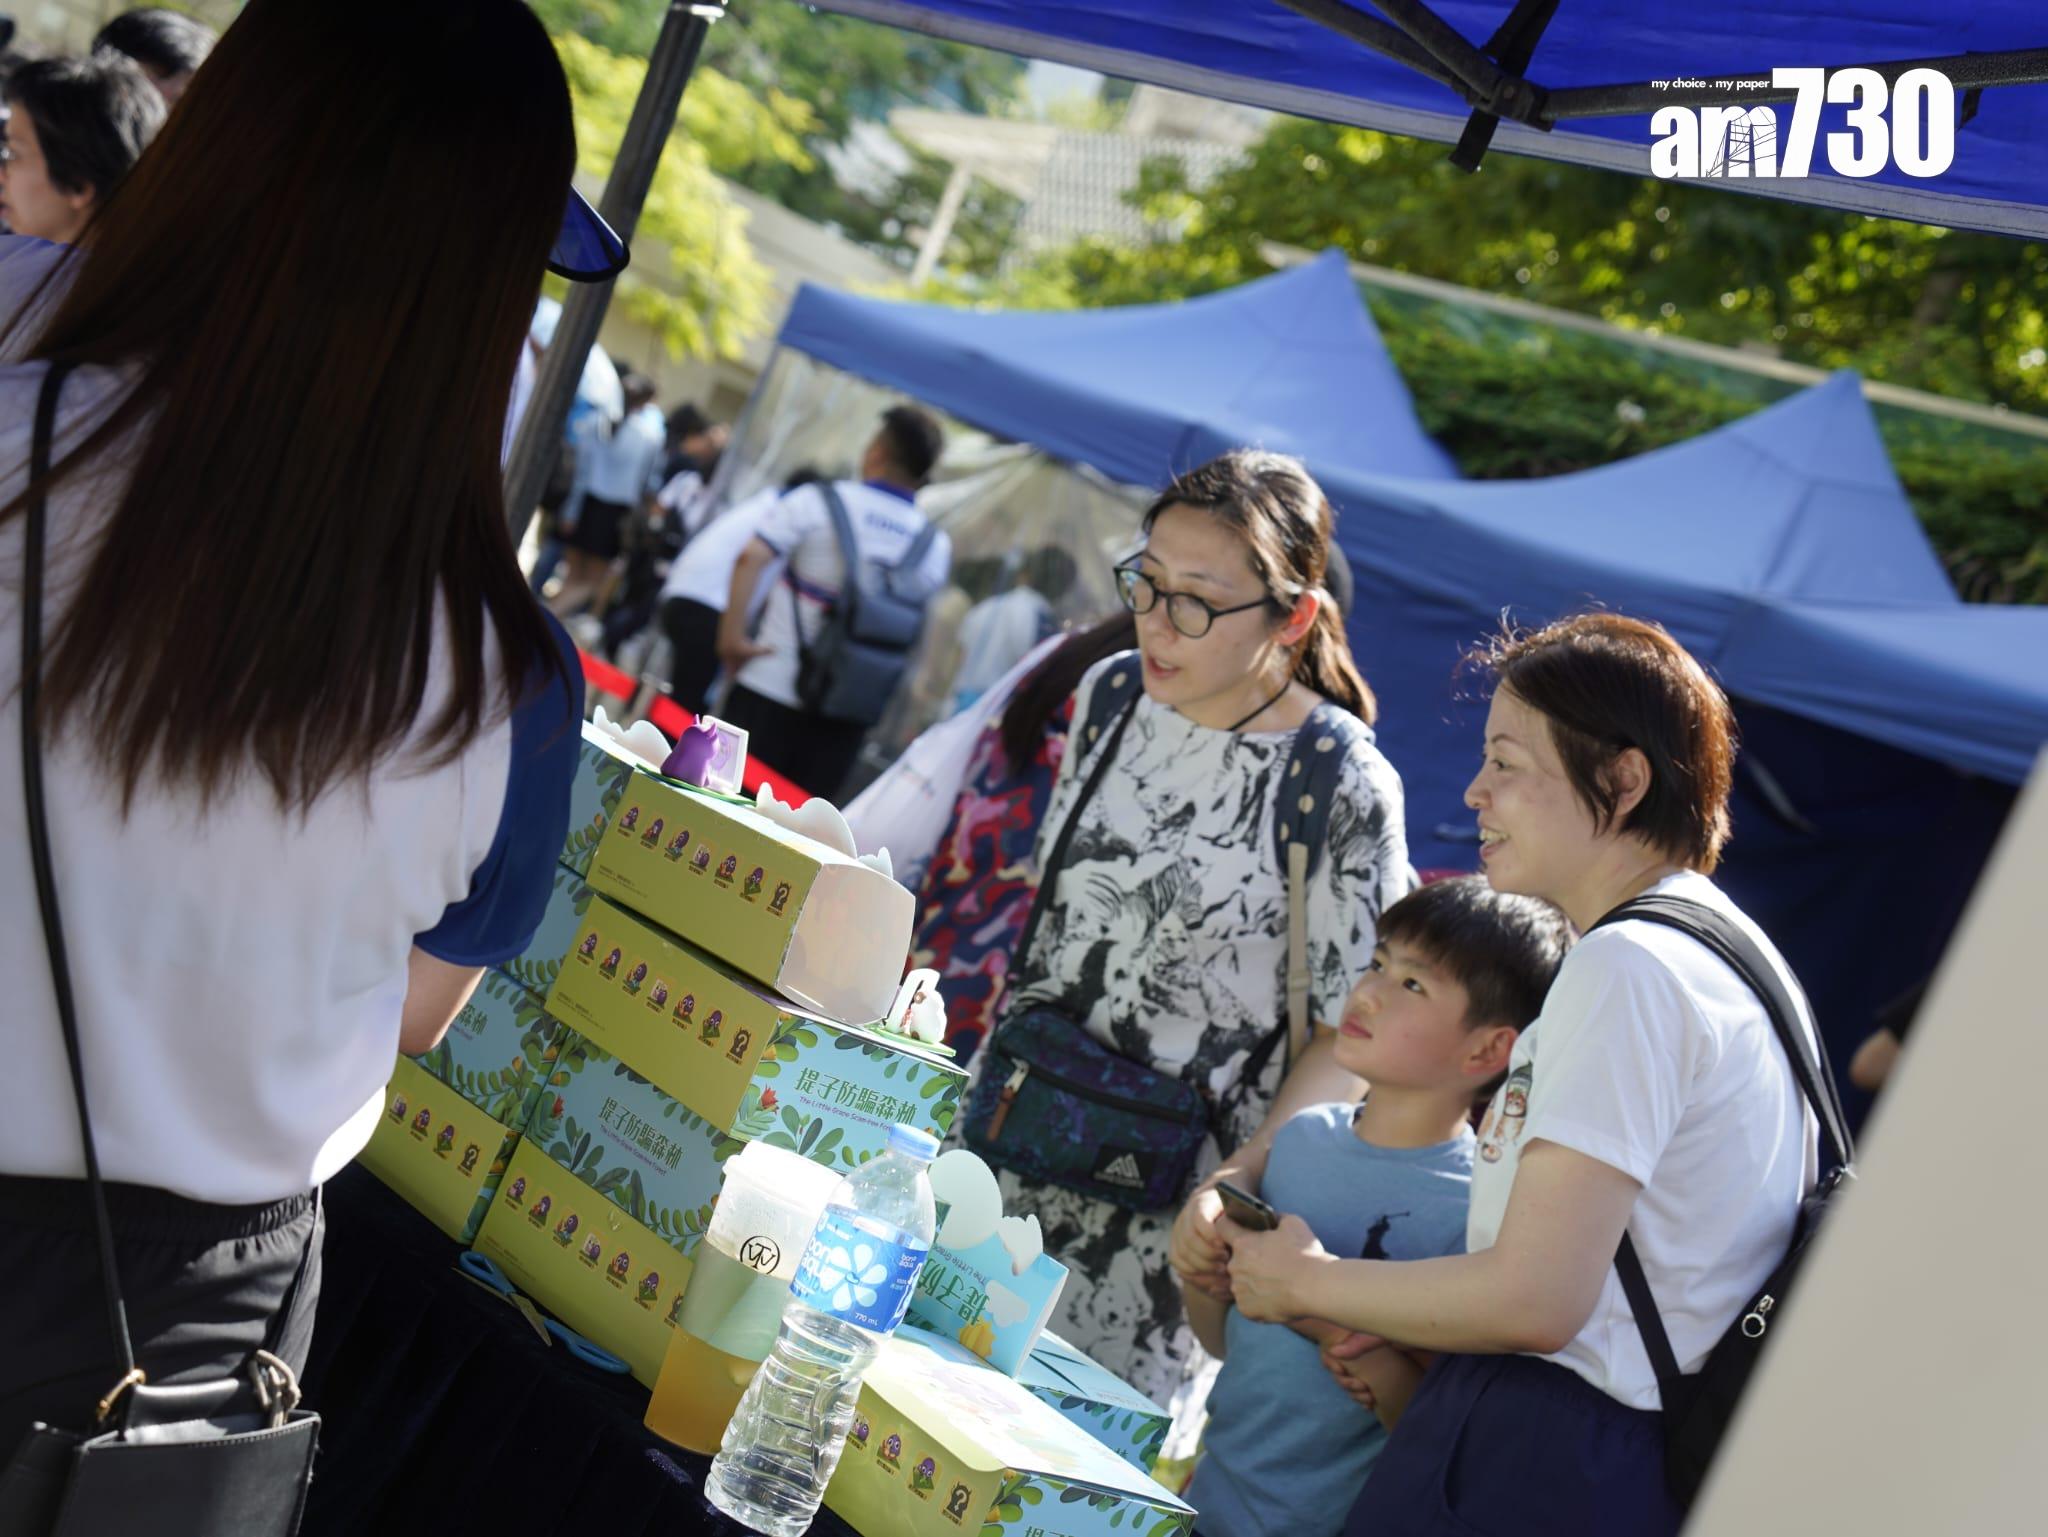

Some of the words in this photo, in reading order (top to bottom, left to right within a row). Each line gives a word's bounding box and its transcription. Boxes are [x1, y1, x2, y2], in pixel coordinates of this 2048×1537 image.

[794, 1067, 917, 1124] 提子防騙森林
[855, 1313, 867, 1322] 770
